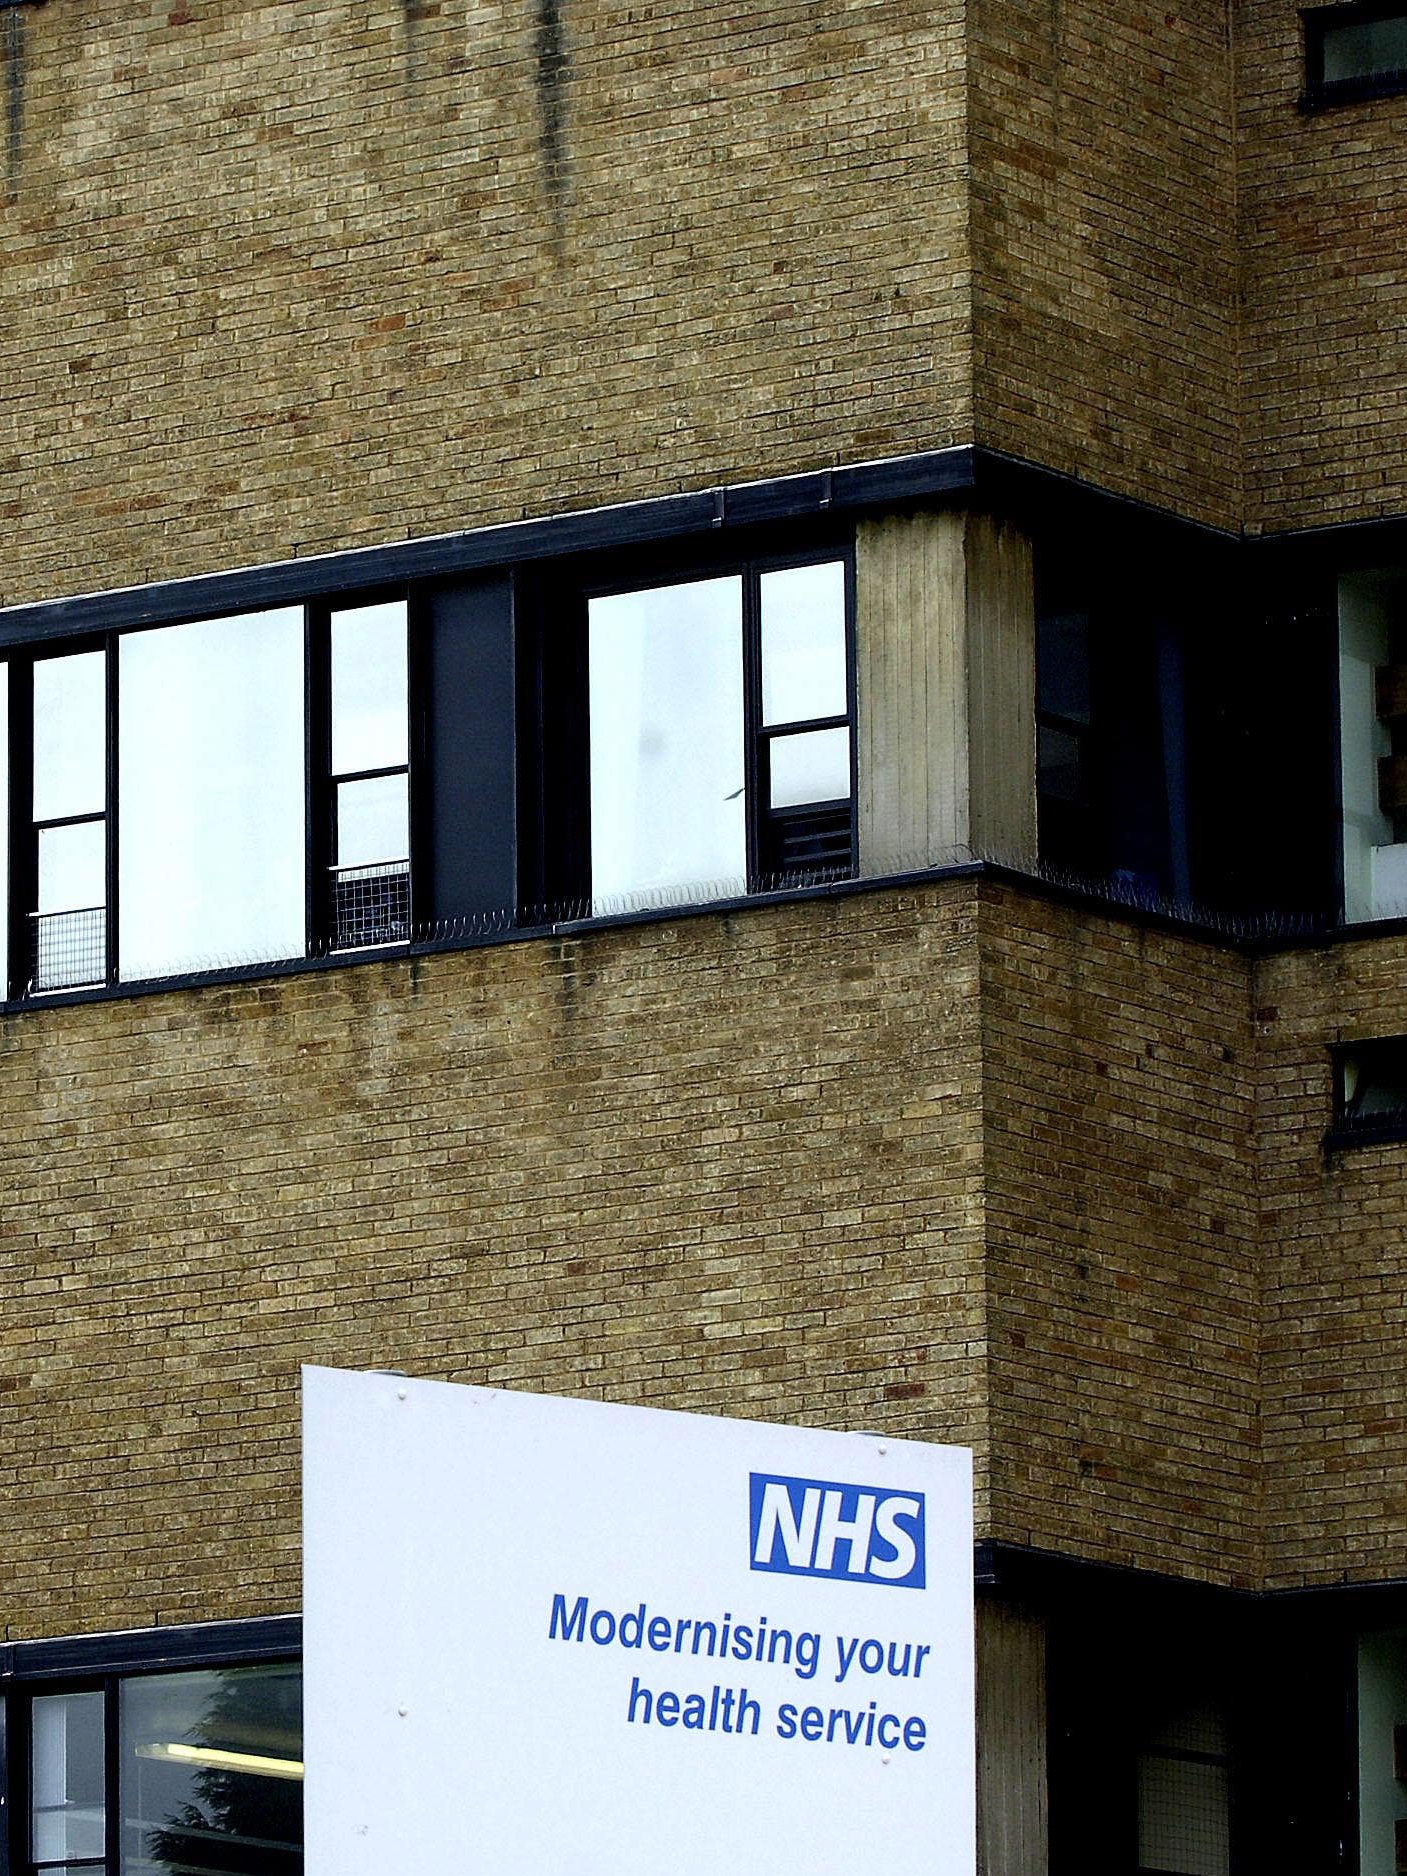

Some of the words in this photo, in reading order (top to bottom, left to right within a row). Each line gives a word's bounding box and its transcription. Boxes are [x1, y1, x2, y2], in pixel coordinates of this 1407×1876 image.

[753, 1482, 920, 1580] NHS
[548, 1593, 821, 1679] Modernising
[835, 1635, 930, 1683] your
[627, 1677, 761, 1735] health
[776, 1702, 927, 1752] service
